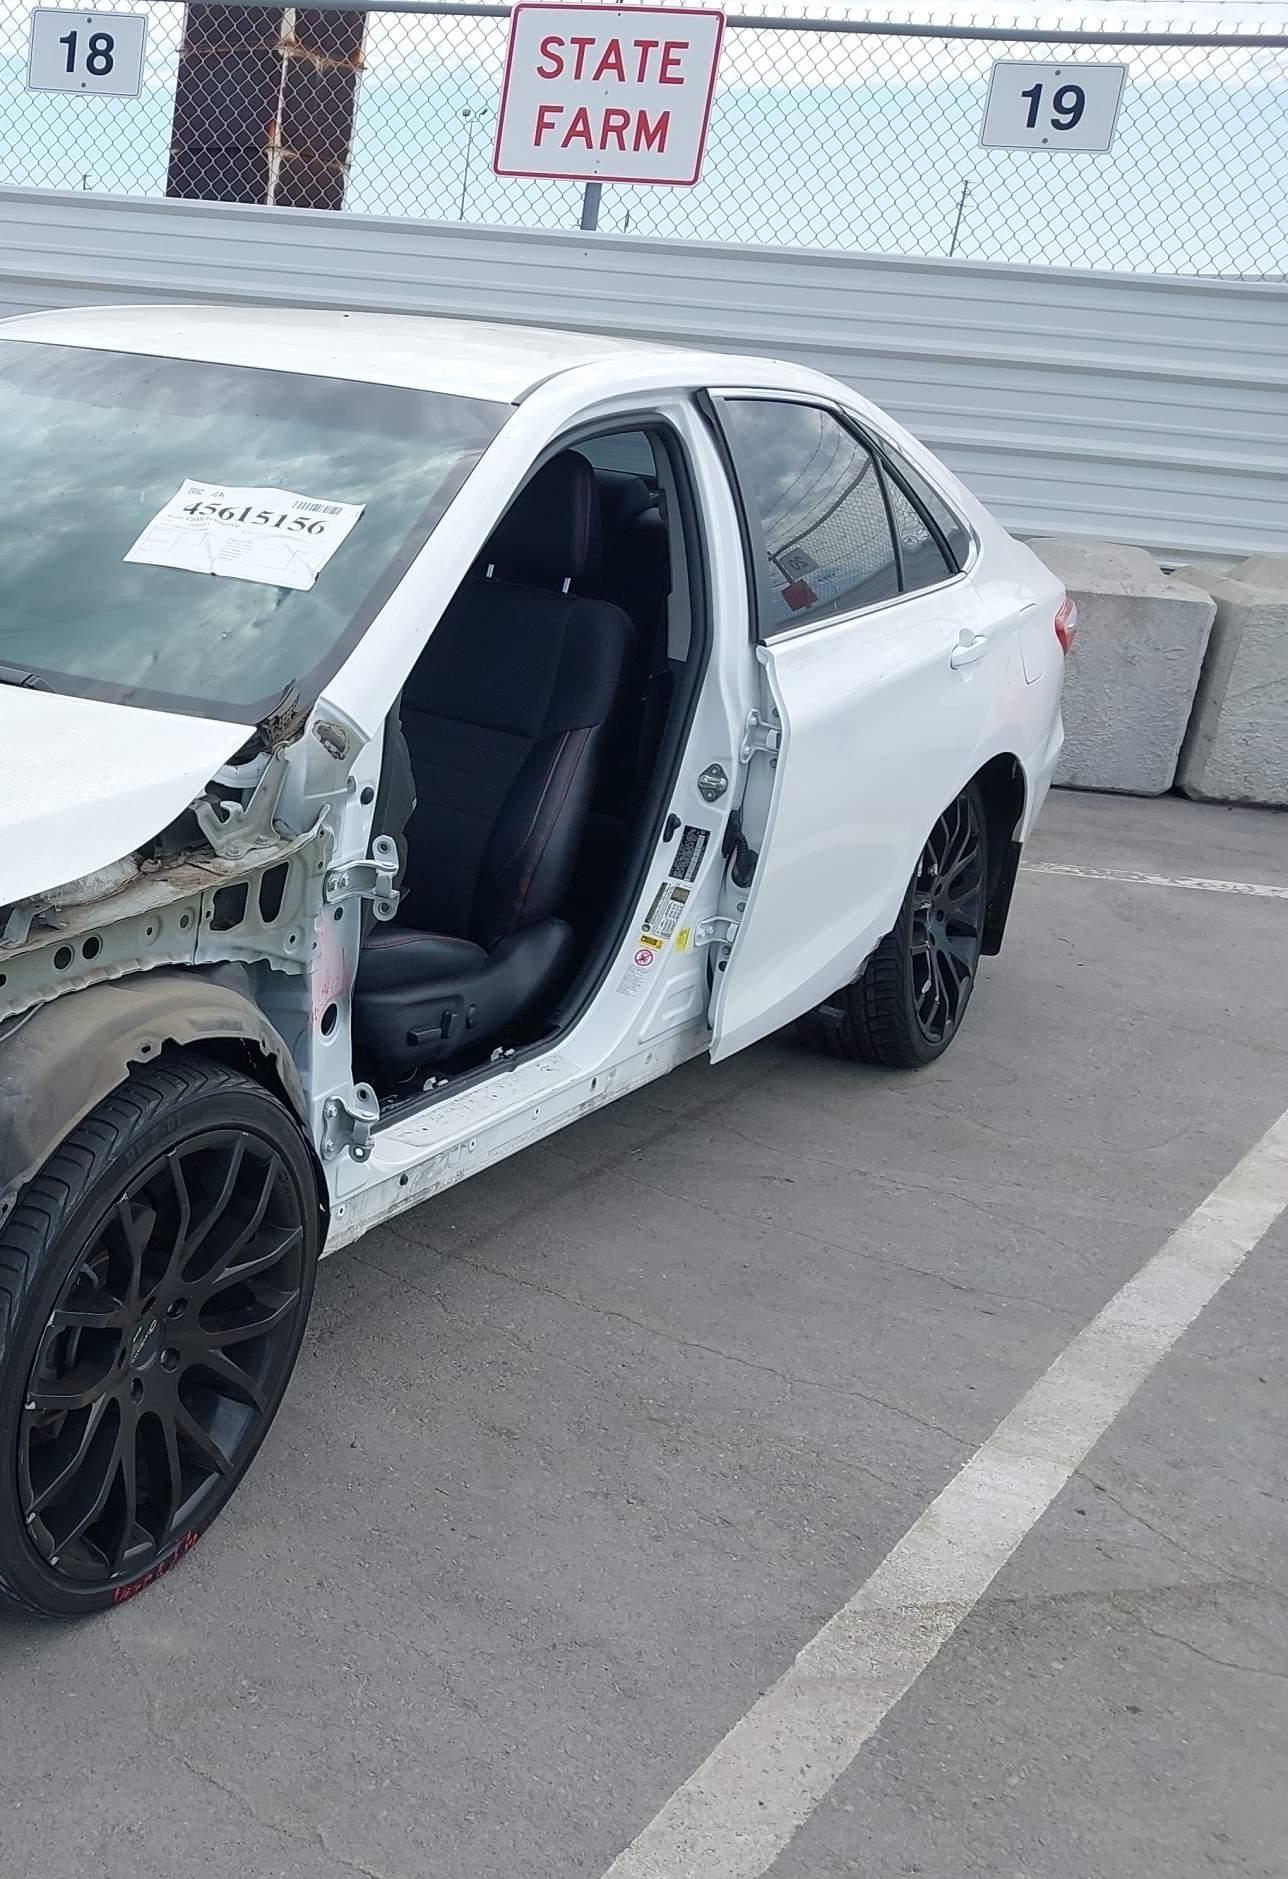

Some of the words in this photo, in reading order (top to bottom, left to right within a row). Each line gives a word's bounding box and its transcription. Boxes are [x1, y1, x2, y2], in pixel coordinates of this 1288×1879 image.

[59, 30, 115, 76] 18
[537, 35, 690, 85] STATE
[534, 104, 671, 153] FARM
[1021, 83, 1086, 131] 19
[183, 501, 329, 535] 45615156
